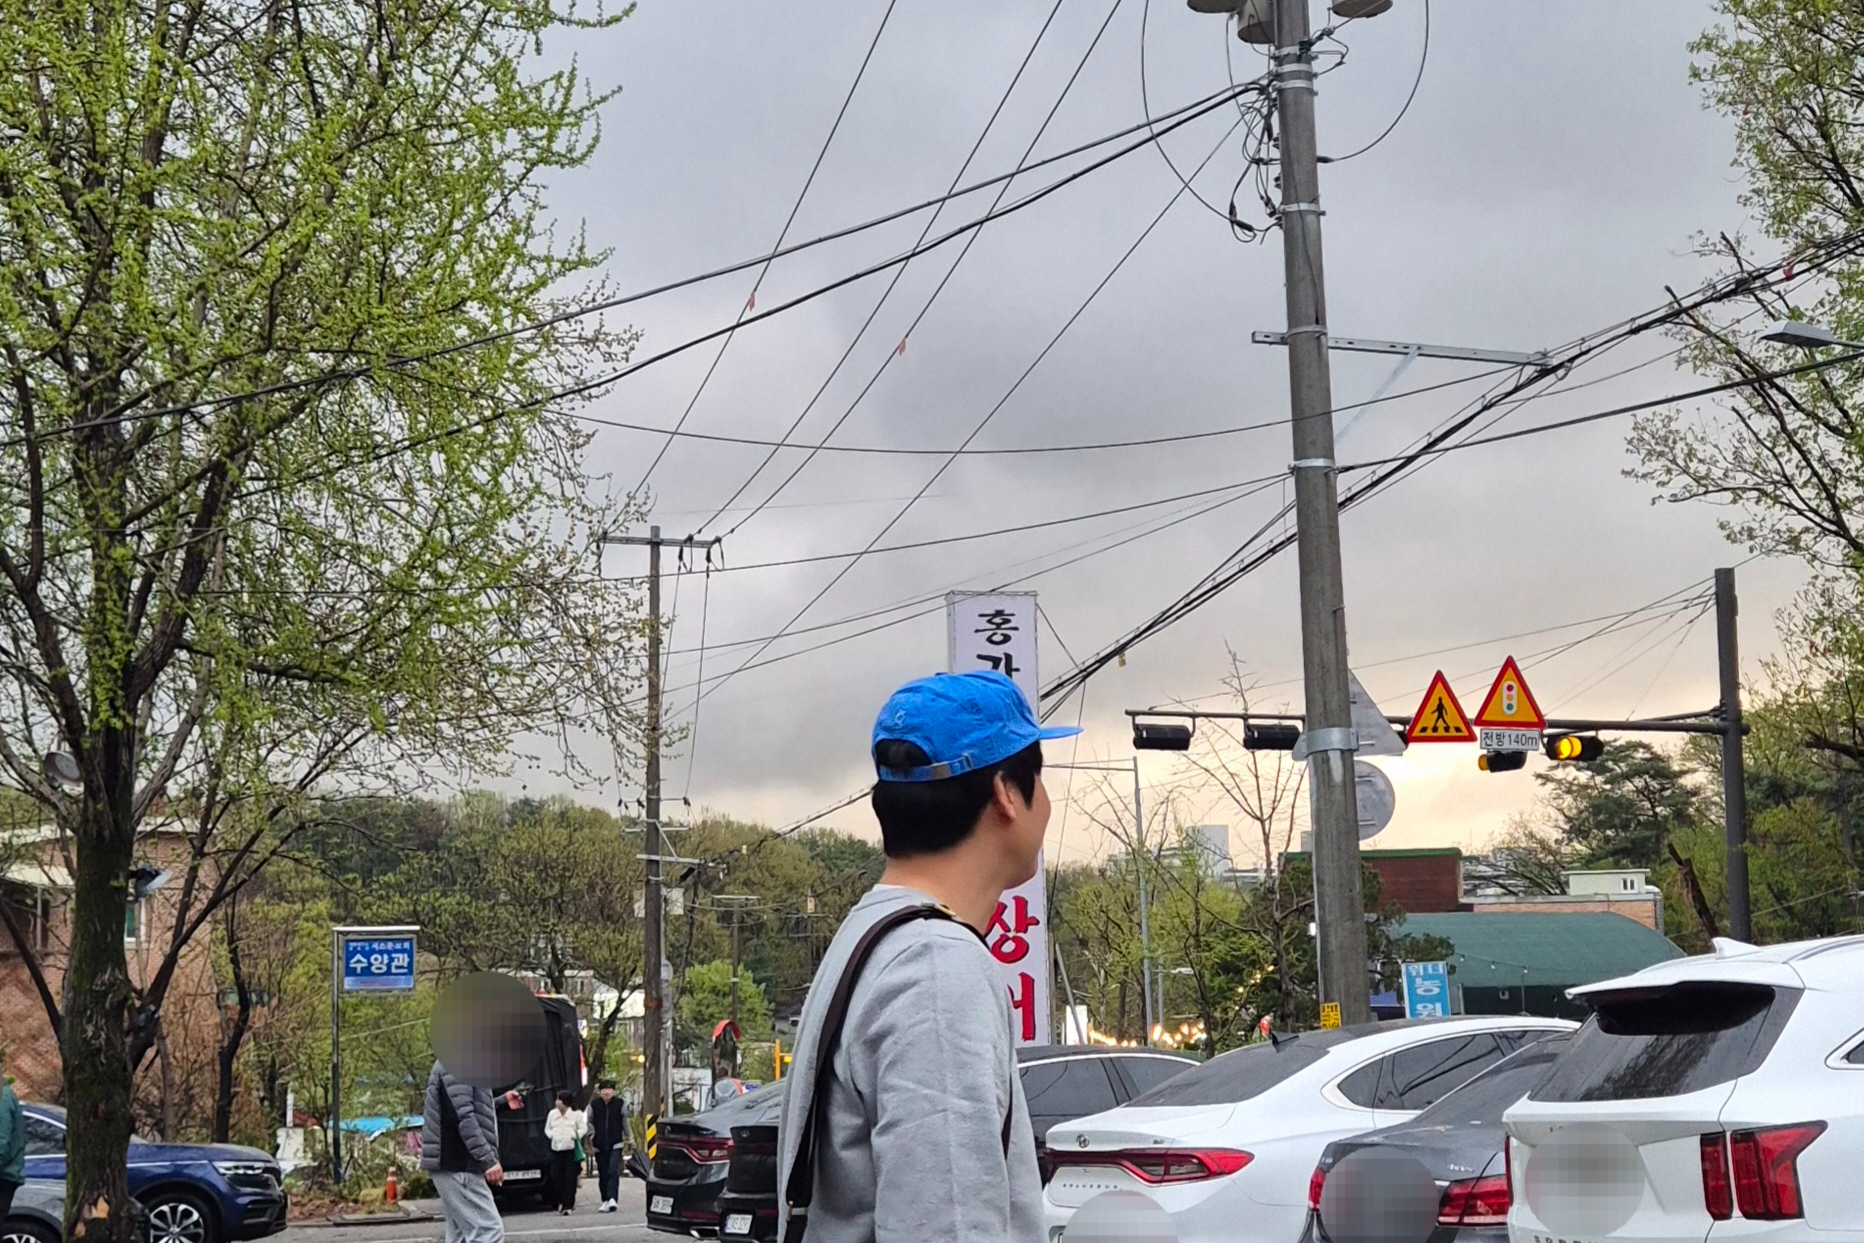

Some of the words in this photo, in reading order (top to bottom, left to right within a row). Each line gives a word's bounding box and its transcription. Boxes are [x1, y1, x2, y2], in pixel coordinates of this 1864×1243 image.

[1483, 731, 1506, 747] 전방
[1508, 733, 1538, 746] 140m
[349, 953, 410, 974] 수양관
